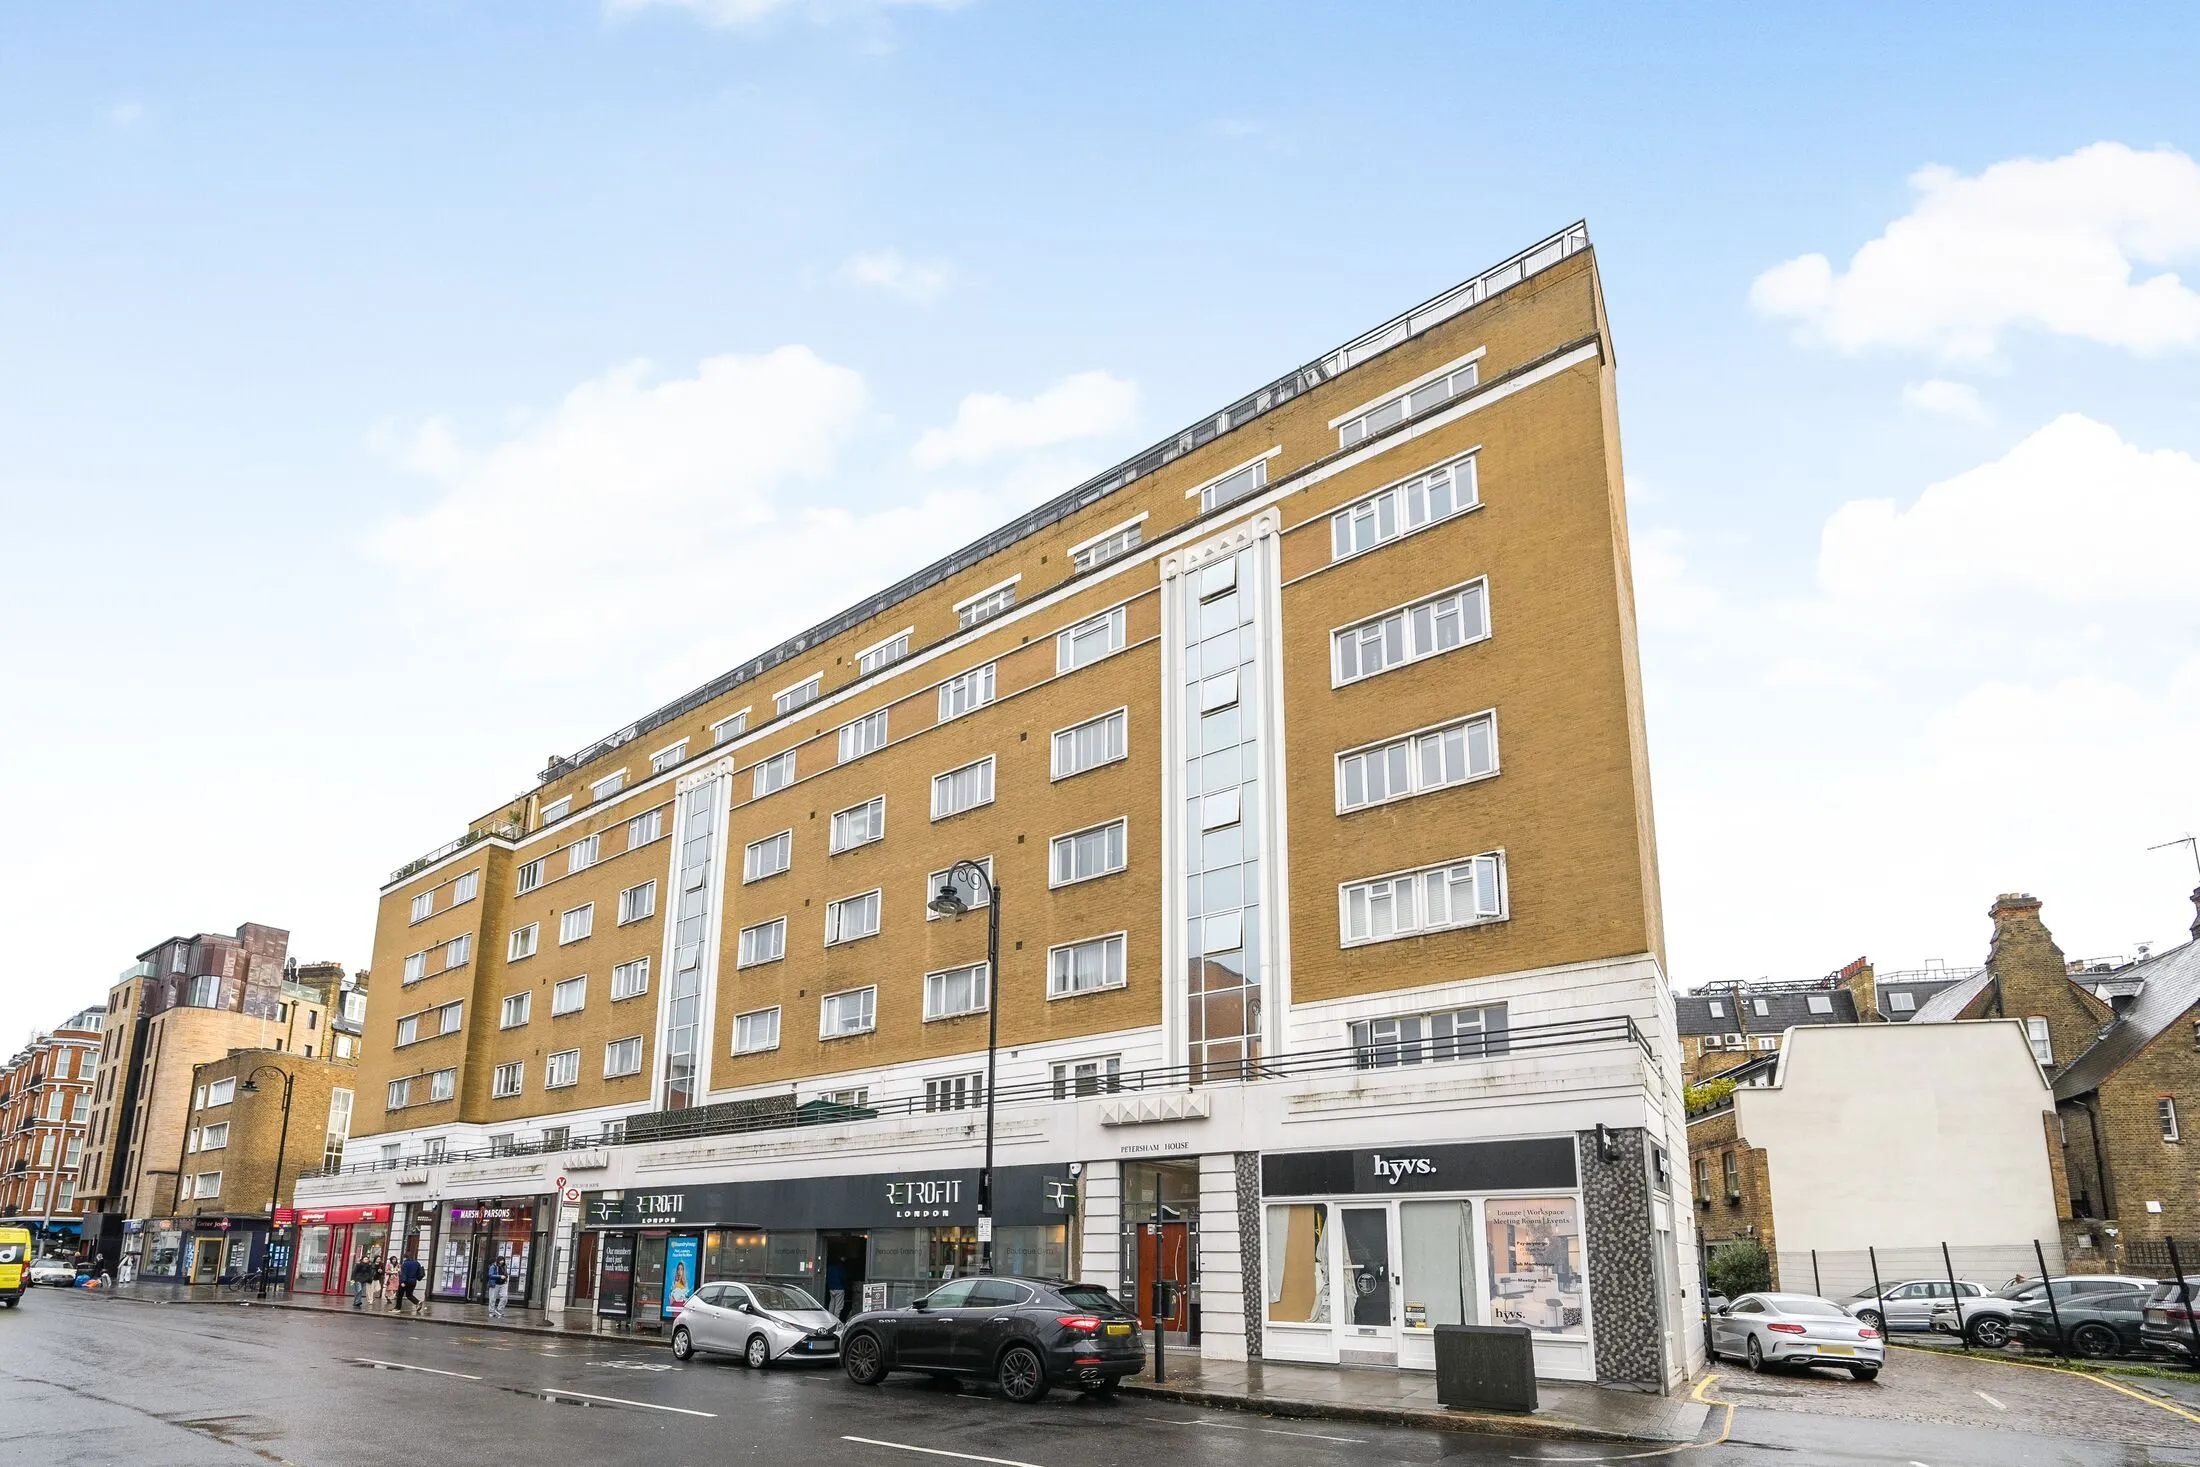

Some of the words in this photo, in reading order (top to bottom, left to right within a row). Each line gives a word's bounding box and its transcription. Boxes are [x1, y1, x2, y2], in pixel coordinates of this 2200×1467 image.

[1121, 1144, 1159, 1153] PETERSHAM
[1164, 1141, 1189, 1151] HOUSE
[886, 1180, 962, 1205] RETROFIT
[636, 1194, 685, 1214] RETROFIT
[460, 1209, 479, 1219] MARSH
[483, 1208, 510, 1218] PARSONS
[896, 1209, 949, 1218] LONDON
[1497, 1209, 1522, 1217] Lounge
[1526, 1208, 1565, 1217] Workspace
[606, 1246, 614, 1255] Our
